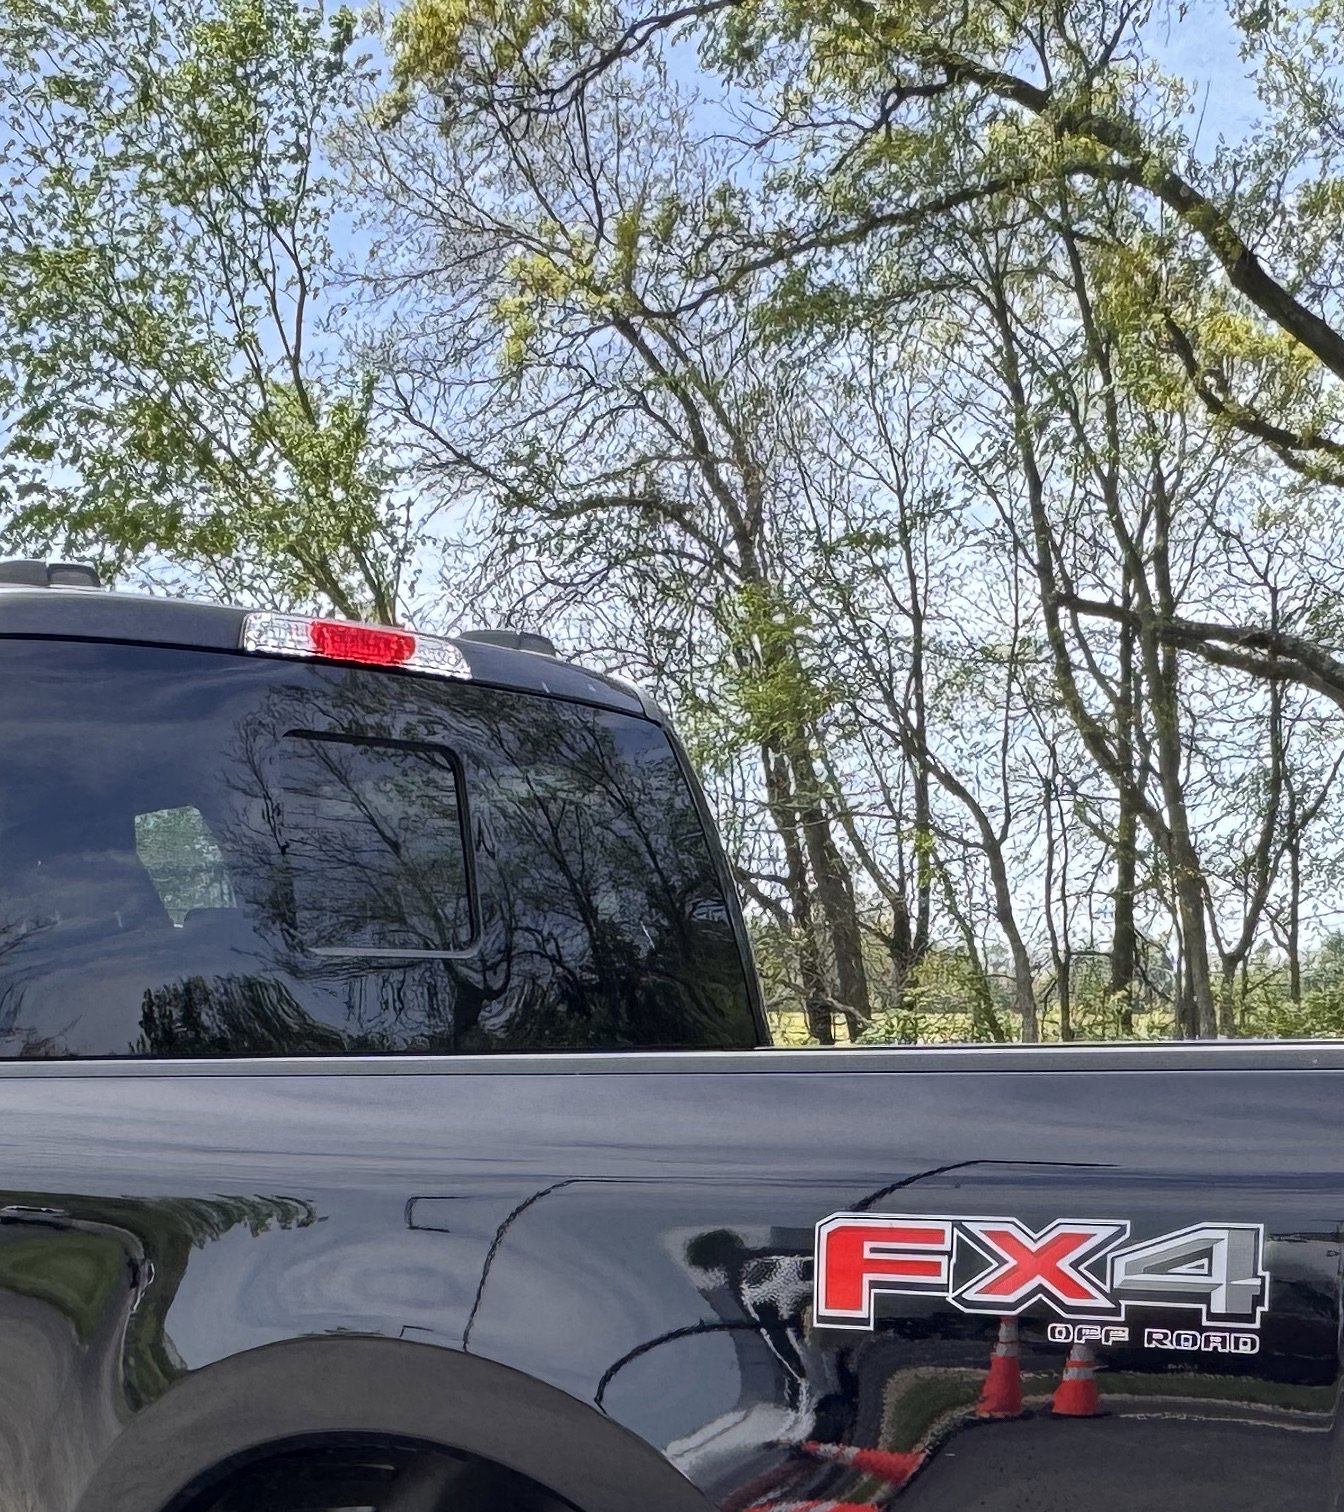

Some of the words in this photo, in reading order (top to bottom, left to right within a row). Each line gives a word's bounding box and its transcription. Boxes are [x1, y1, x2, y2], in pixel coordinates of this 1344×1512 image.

[813, 1211, 1270, 1330] FX4
[1047, 1323, 1129, 1344] OFF
[1144, 1328, 1260, 1354] ROAD
